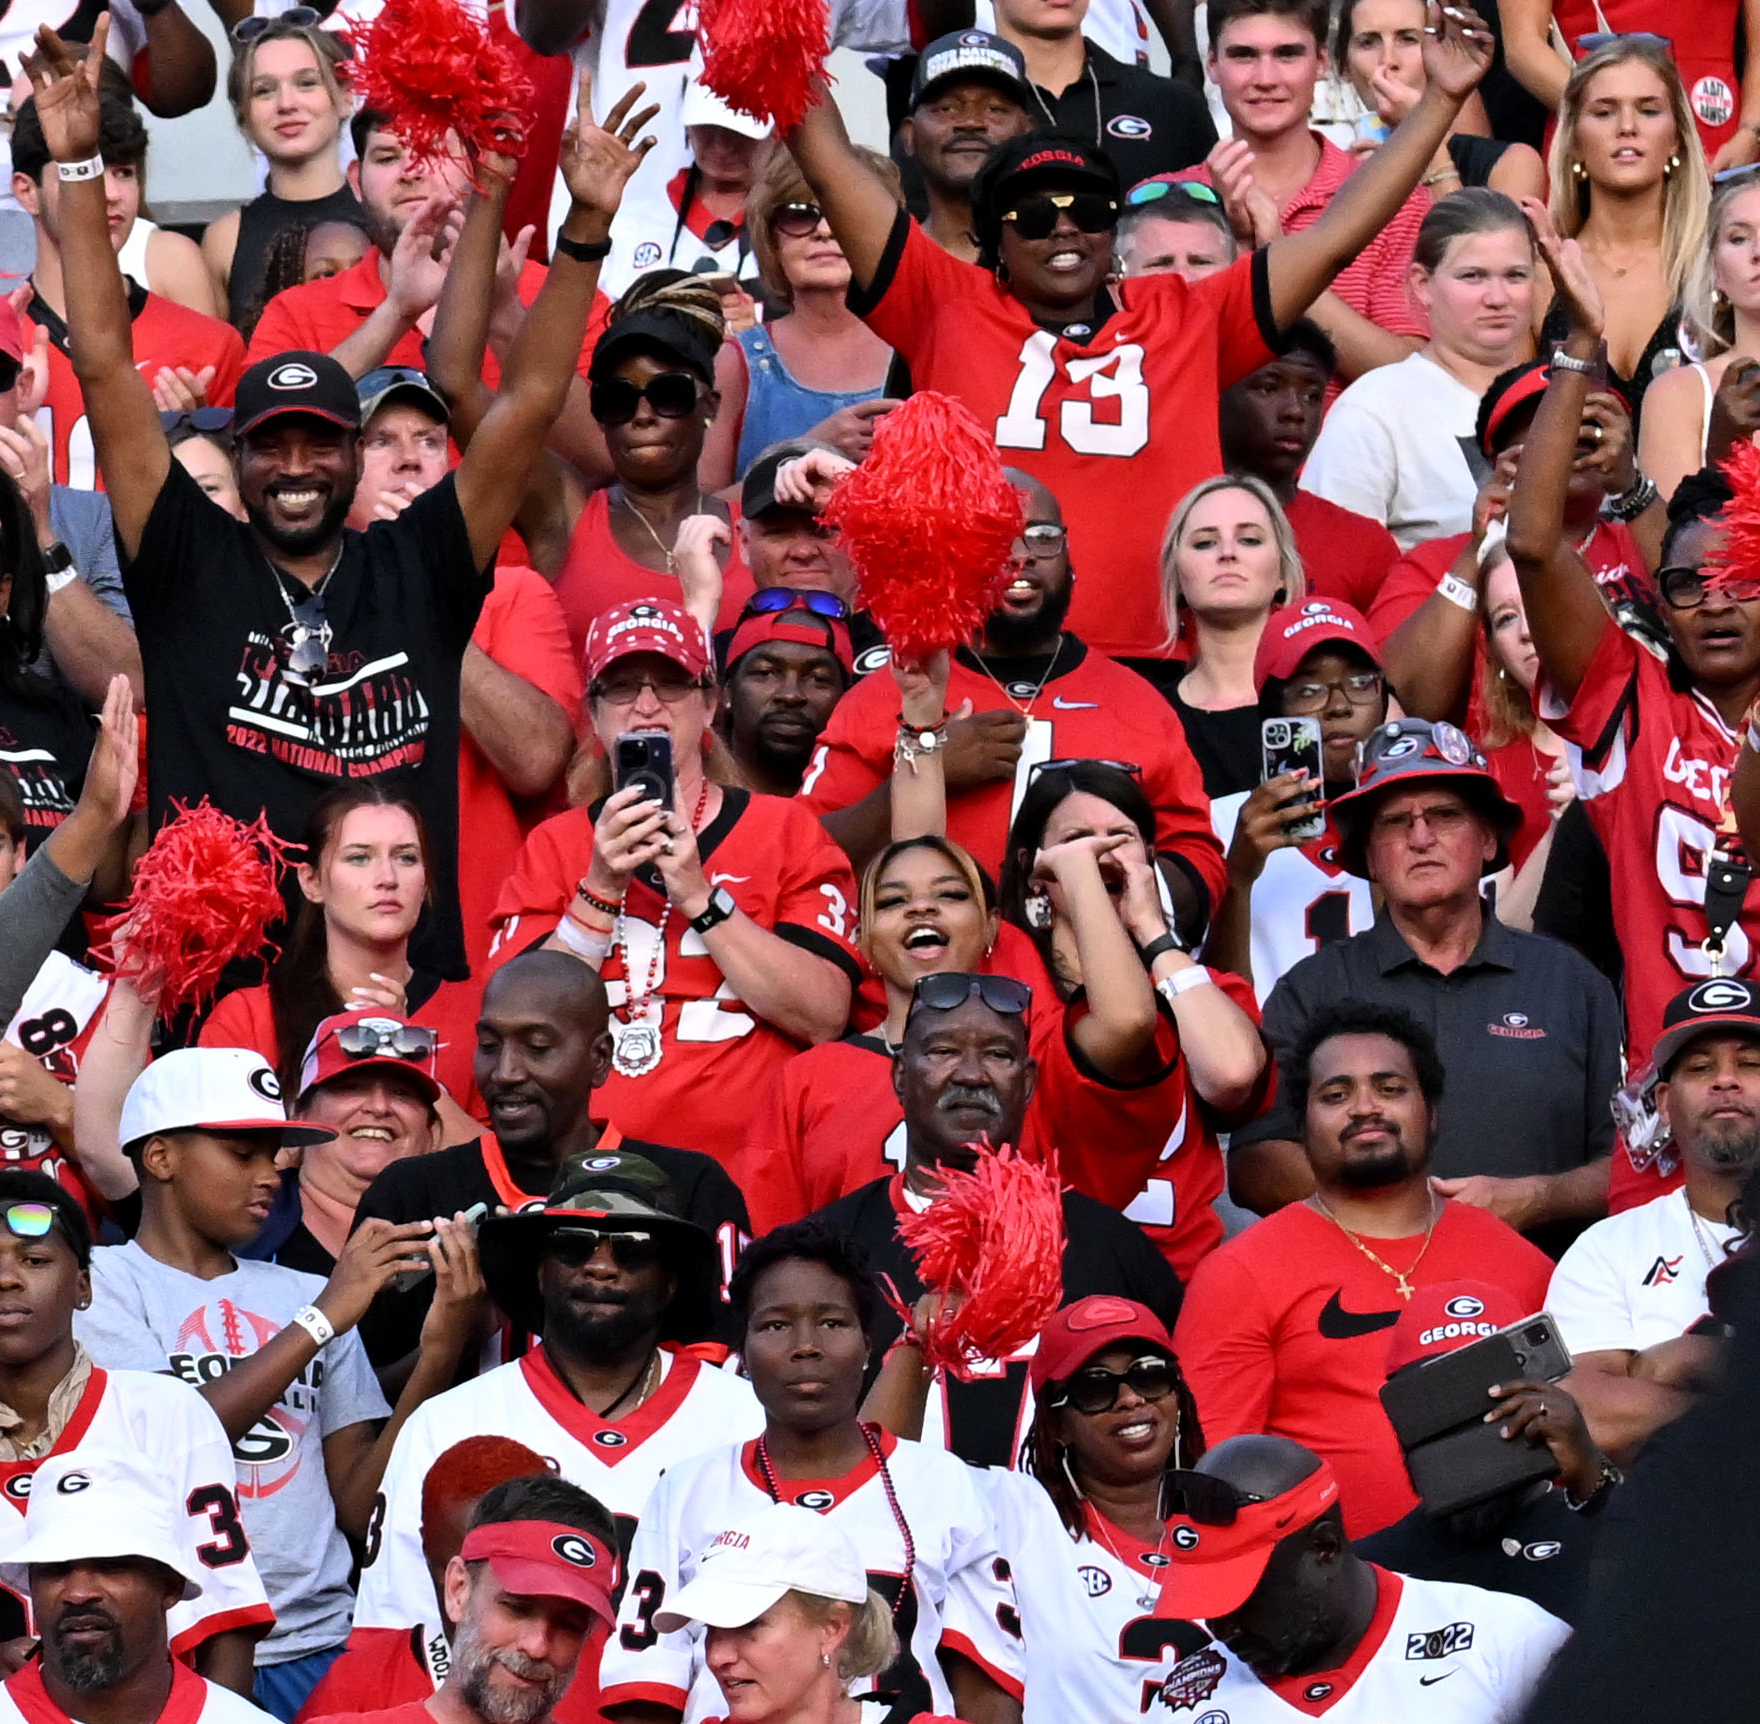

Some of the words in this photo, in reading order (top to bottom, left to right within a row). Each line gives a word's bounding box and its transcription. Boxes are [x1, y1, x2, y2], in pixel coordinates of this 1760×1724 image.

[1111, 116, 1151, 136] G
[272, 365, 317, 387] G
[995, 330, 1148, 455] 13
[608, 617, 676, 637] GEORGIA
[1284, 614, 1354, 638] GEORGIA
[227, 724, 266, 754] 2022
[1692, 982, 1750, 1008] G
[1449, 1298, 1483, 1316] G
[1418, 1322, 1500, 1346] GEORGI
[596, 1432, 626, 1446] G
[57, 1474, 91, 1495] G
[797, 1491, 832, 1509] G
[1173, 1526, 1199, 1549] G
[555, 1536, 596, 1565] G
[1527, 1542, 1560, 1559] G
[620, 1569, 667, 1652] 3
[1306, 1684, 1330, 1701] G
